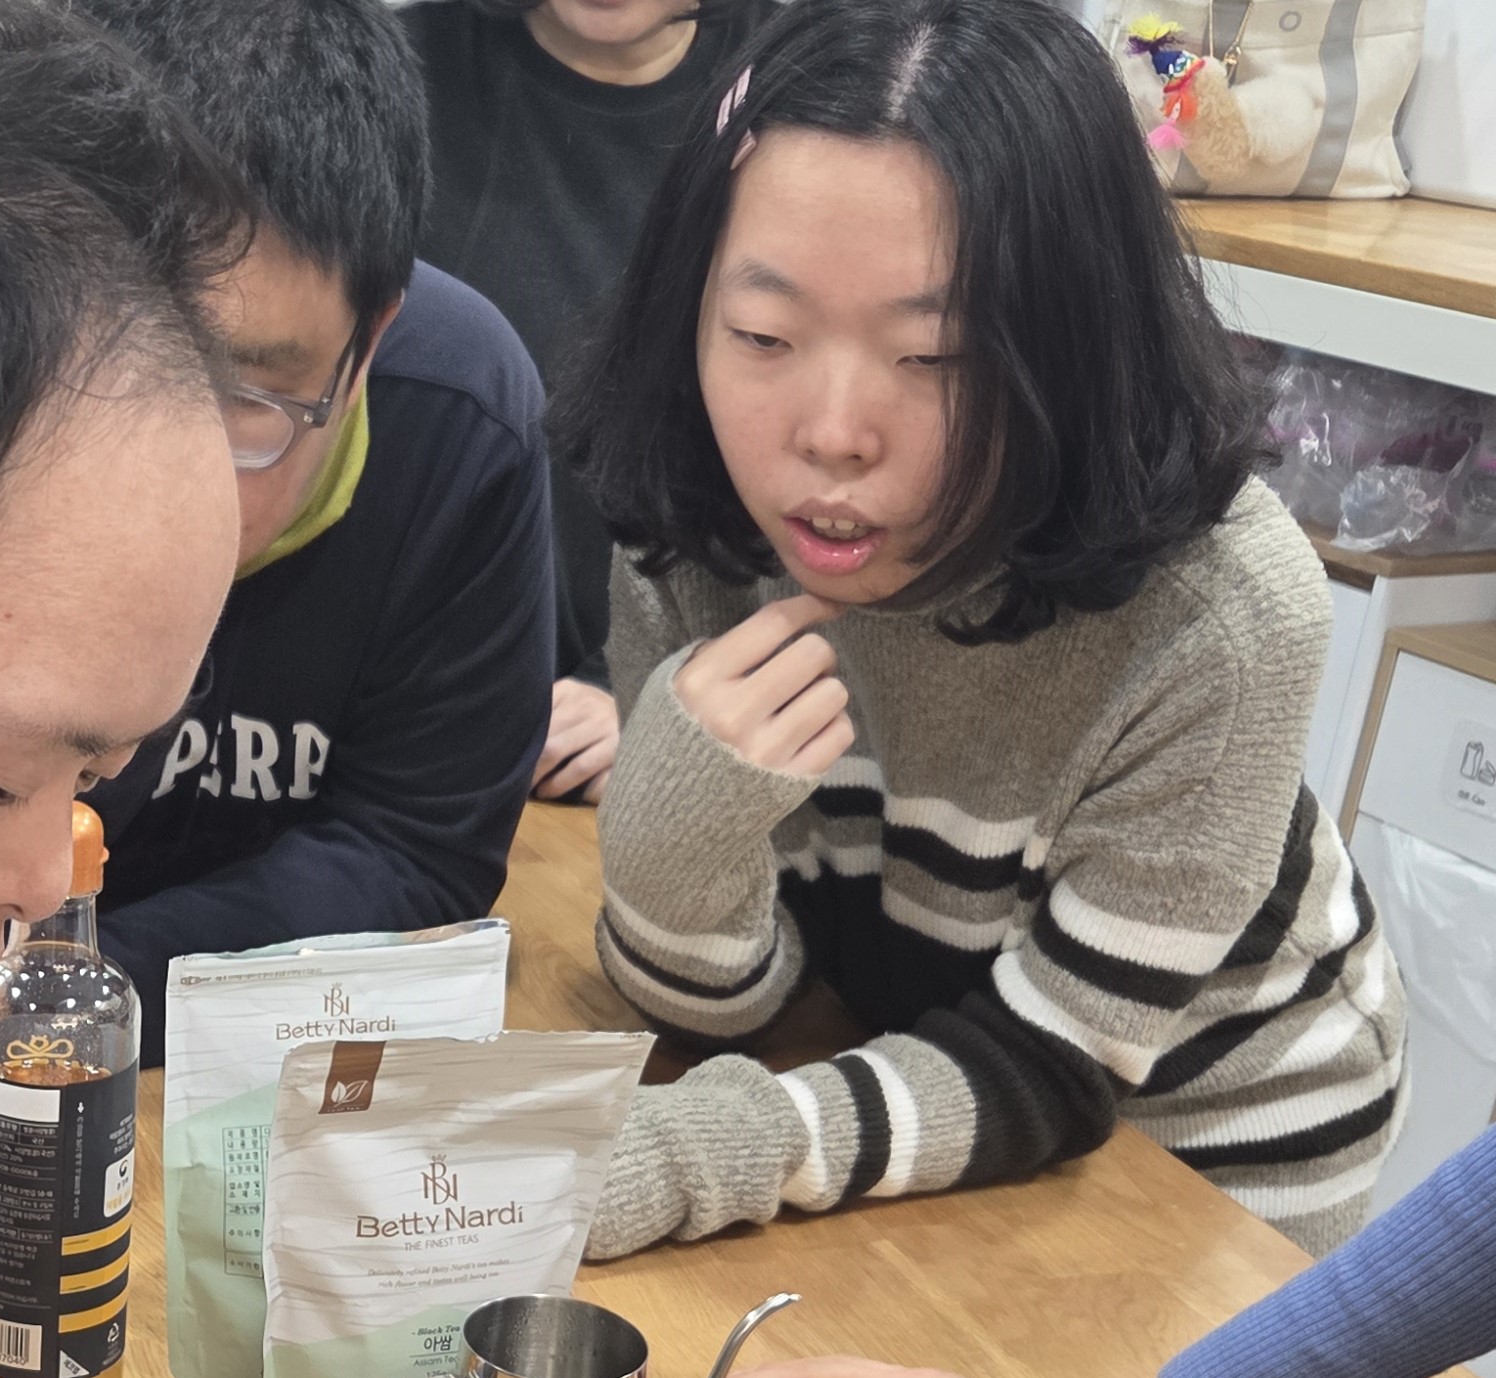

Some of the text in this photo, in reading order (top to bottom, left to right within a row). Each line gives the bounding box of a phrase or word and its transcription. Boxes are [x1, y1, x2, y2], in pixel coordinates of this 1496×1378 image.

[275, 1015, 396, 1040] Betty Nardi
[356, 1201, 524, 1238] Betty Nardi
[404, 1234, 479, 1251] THE FINEST TEAS
[417, 1326, 442, 1336] Black
[424, 1335, 453, 1353] 아쌈
[413, 1357, 442, 1367] Assam
